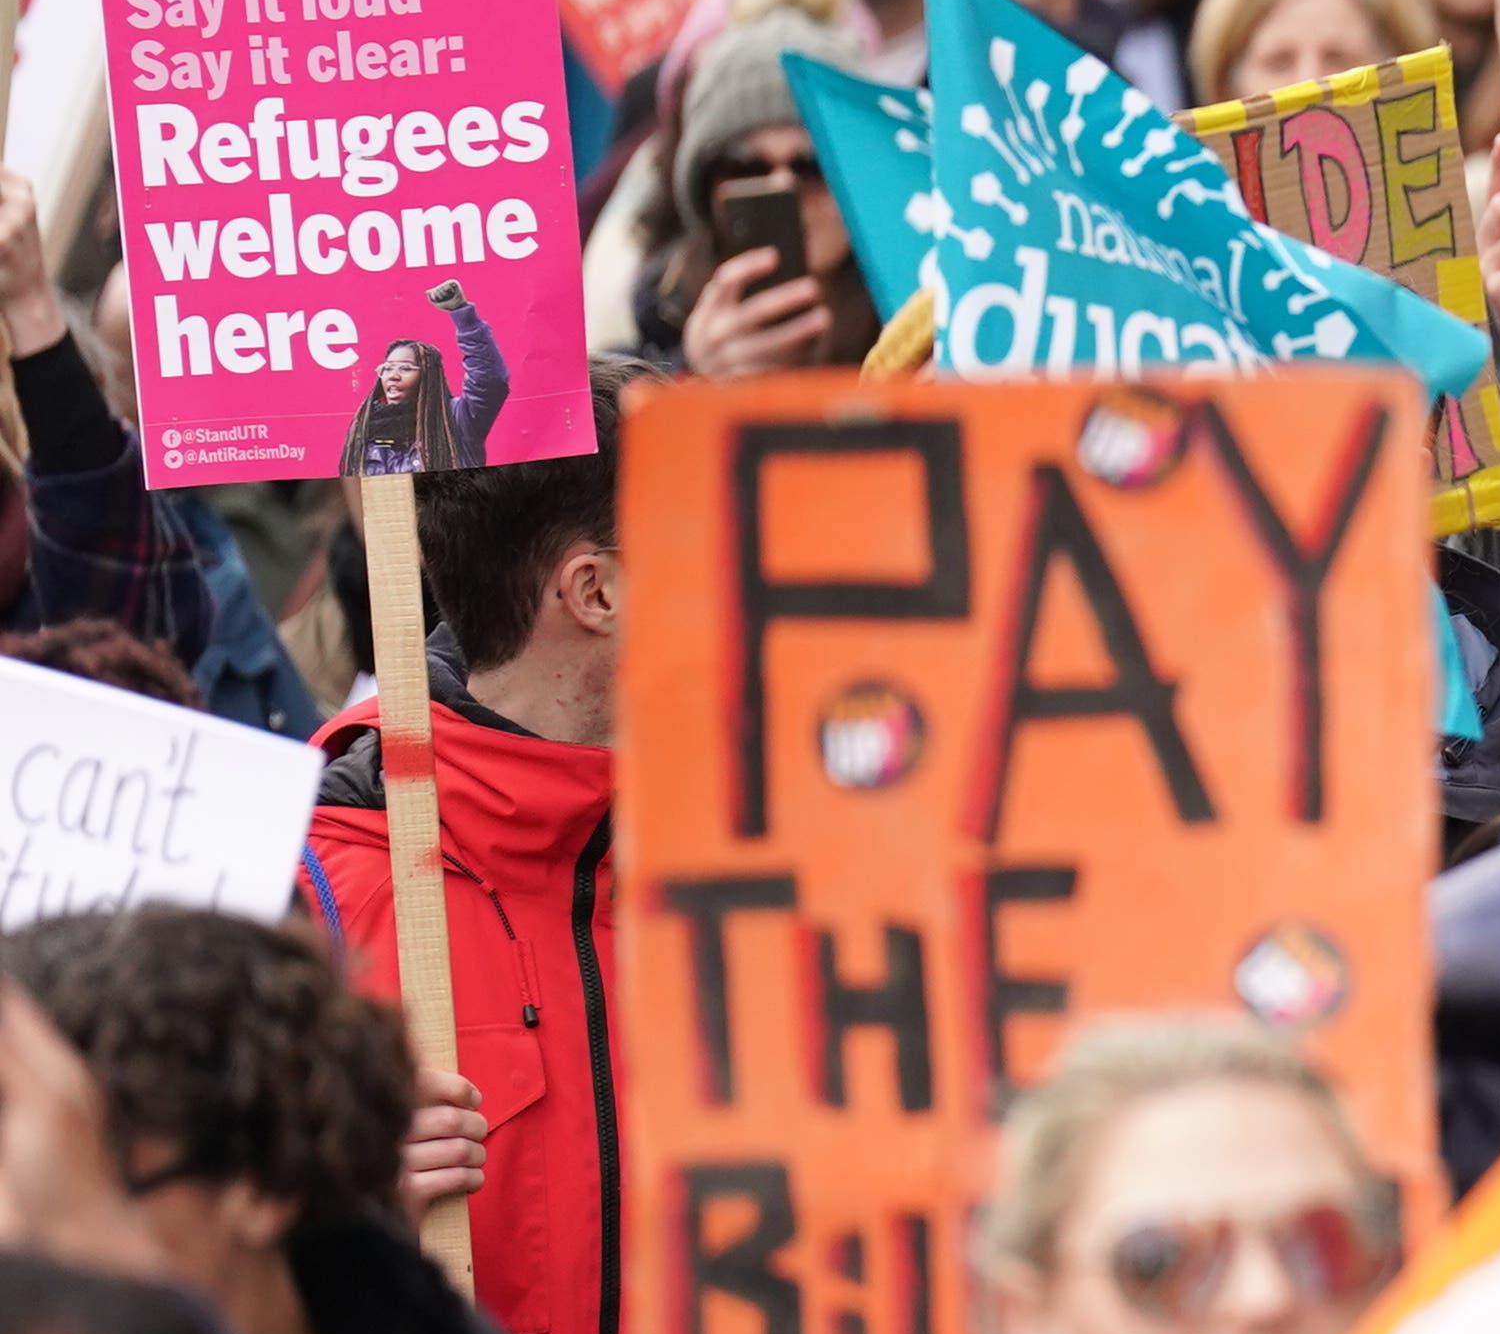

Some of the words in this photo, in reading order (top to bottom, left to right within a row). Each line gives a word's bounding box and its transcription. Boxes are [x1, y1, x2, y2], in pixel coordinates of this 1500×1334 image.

[131, 38, 232, 101] Say
[250, 34, 292, 86] it
[306, 29, 466, 83] clear:
[135, 96, 550, 198] Refugees
[143, 192, 540, 283] welcome
[153, 293, 359, 379] here
[181, 424, 269, 444] @StandUTR
[182, 443, 306, 465] @AntiRacismDay
[722, 395, 1394, 849] PAY
[652, 861, 1084, 1129] THE
